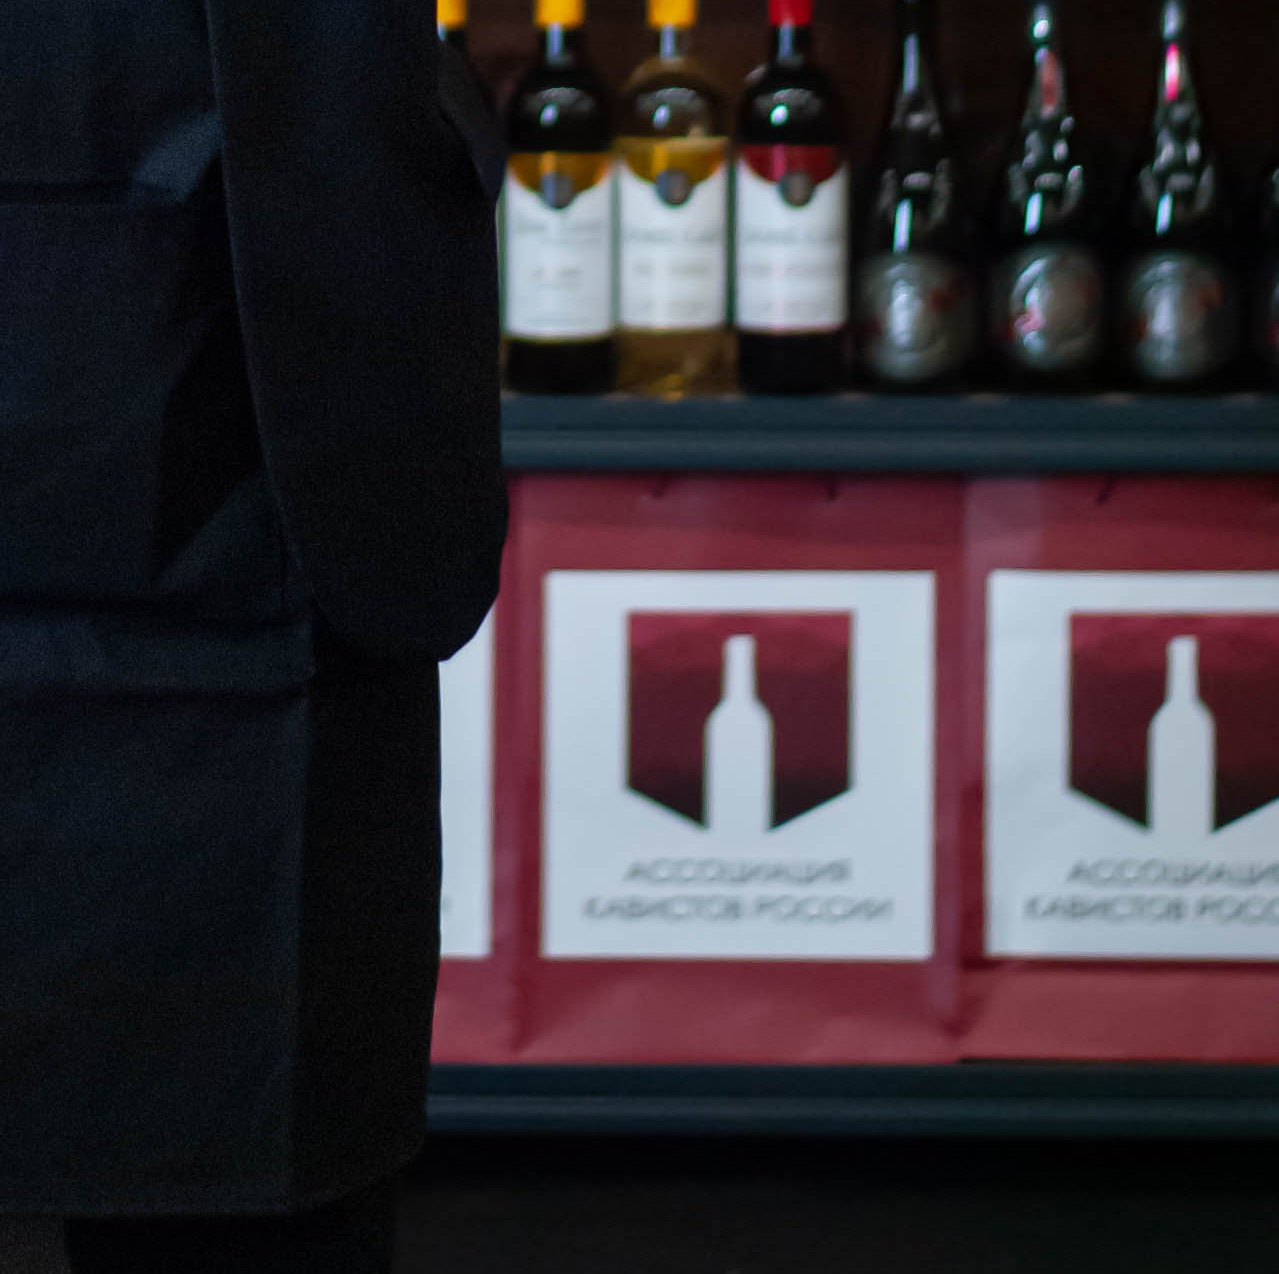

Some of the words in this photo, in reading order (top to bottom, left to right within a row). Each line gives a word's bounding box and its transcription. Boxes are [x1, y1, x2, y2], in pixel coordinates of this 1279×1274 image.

[622, 856, 851, 885] АССОЦИАЦИЯ
[581, 894, 741, 922] КАВИСТОВ
[753, 894, 894, 924] РОССИИ
